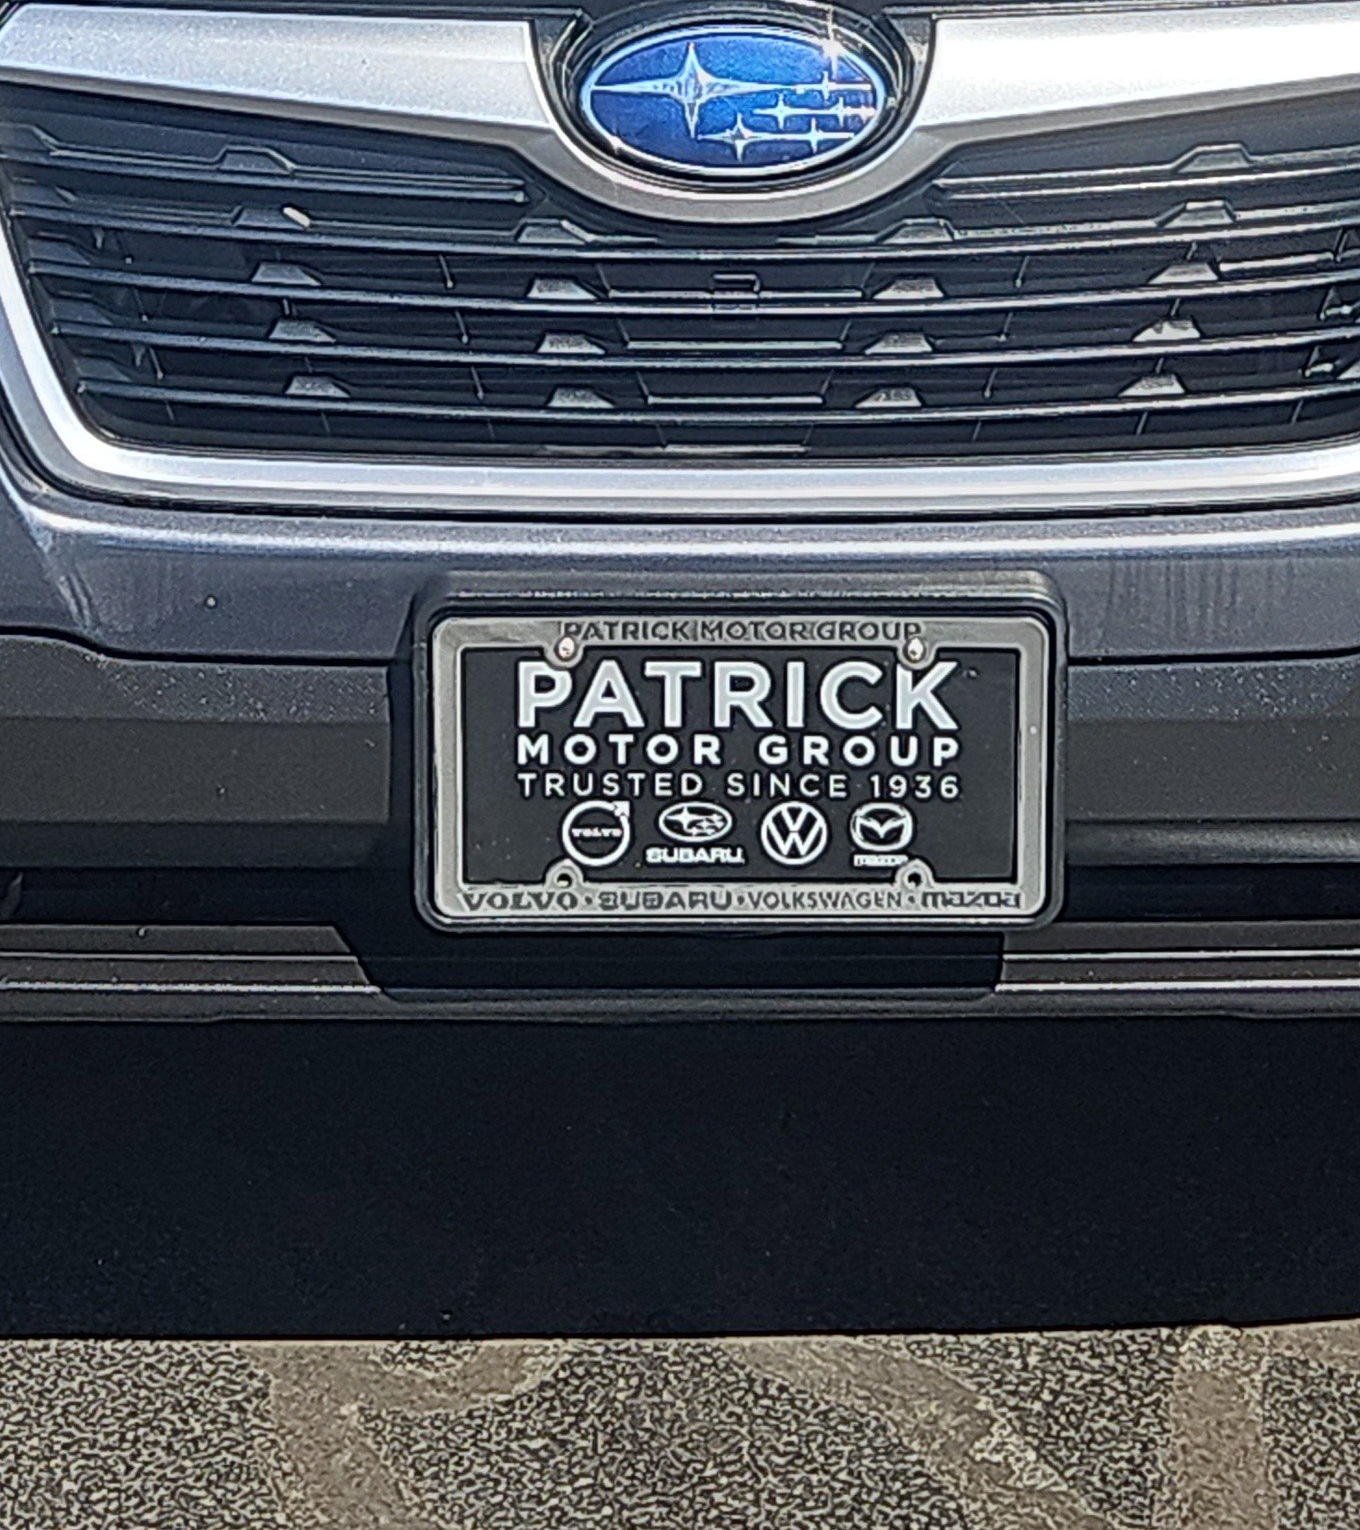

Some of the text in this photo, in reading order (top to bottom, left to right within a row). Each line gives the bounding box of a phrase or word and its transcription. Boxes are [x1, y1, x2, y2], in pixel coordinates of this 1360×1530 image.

[562, 621, 922, 641] PATRICK MOTOR GROUP
[518, 659, 959, 730] PATRICK
[517, 733, 959, 768] MOTOR GROUP
[517, 772, 959, 800] TRUSTED SINCE 1936
[571, 826, 623, 839] VOLVO
[645, 846, 745, 864] SUBARU
[462, 890, 578, 910] VOLVO
[597, 890, 733, 911] SUBARU
[747, 890, 902, 910] VOLKSWAGEN
